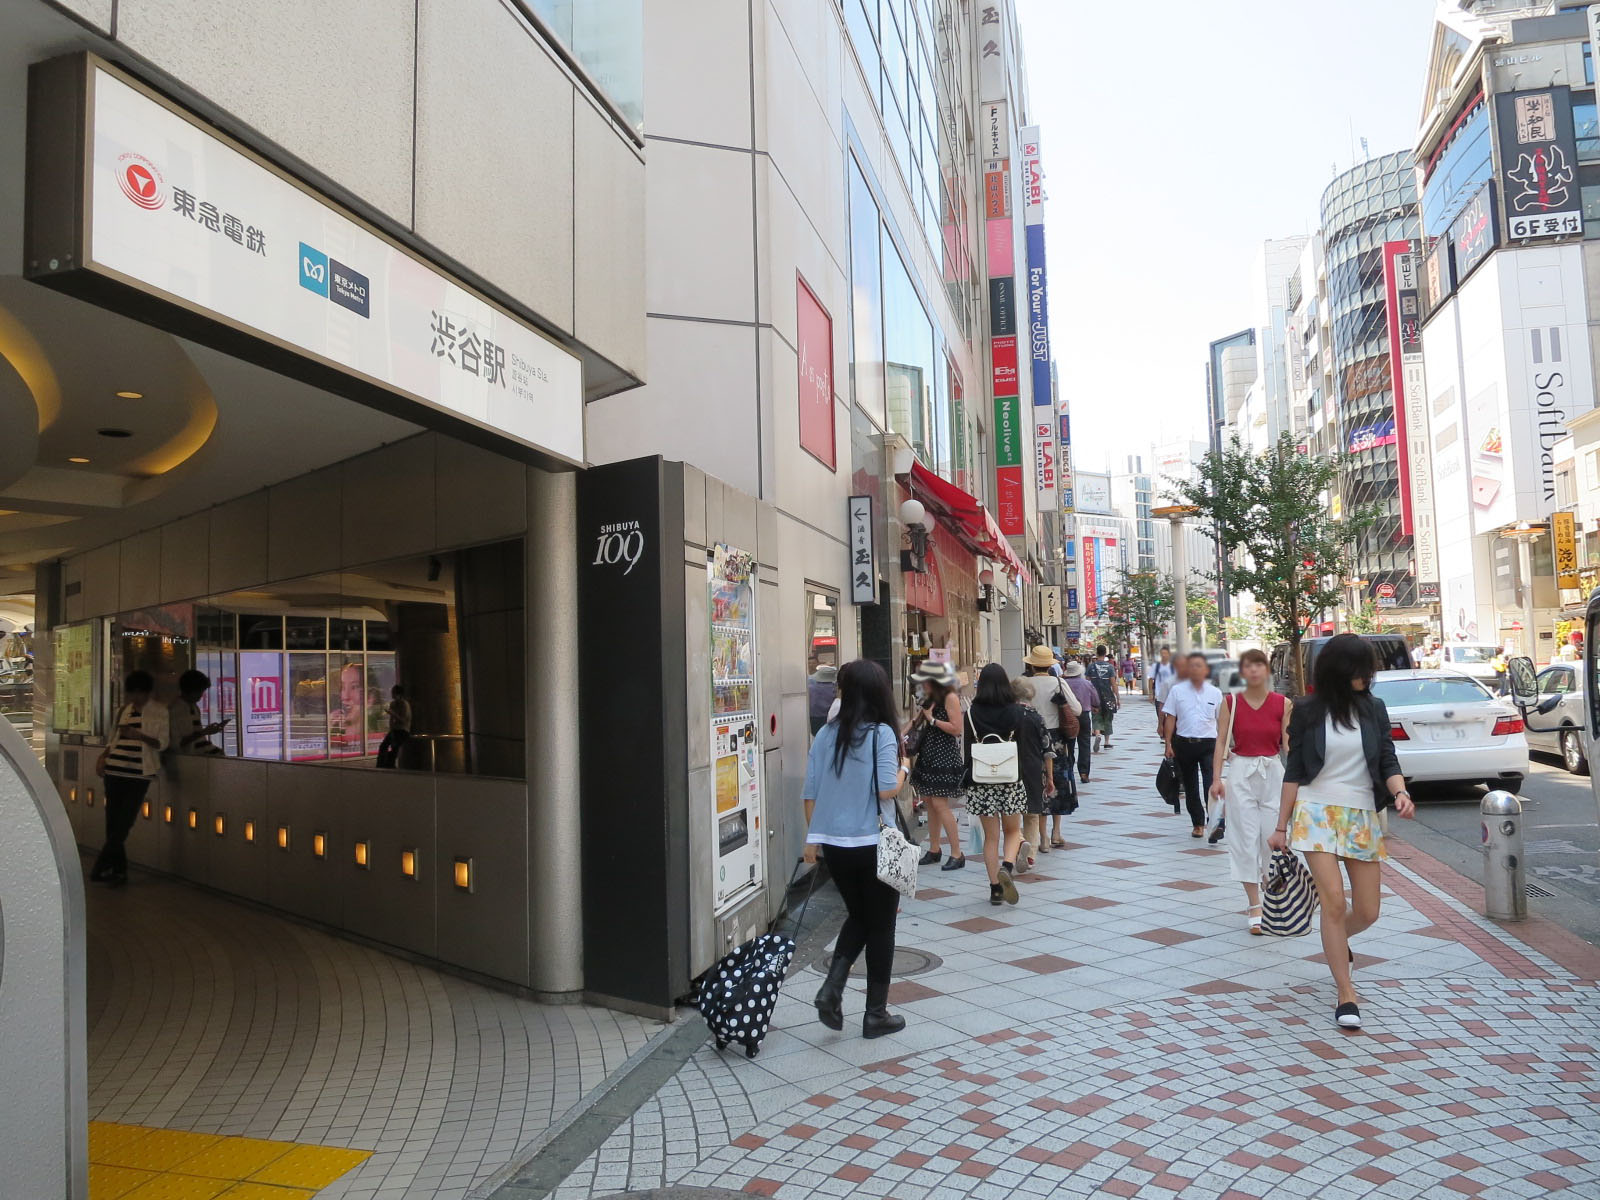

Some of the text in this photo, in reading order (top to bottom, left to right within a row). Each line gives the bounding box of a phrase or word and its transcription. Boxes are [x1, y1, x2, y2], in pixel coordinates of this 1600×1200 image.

[1030, 160, 1041, 205] LABI
[172, 186, 267, 257] 東急電鉄
[334, 273, 366, 297] 東京メトロ
[336, 284, 350, 297] Tokyo
[1031, 267, 1042, 286] For
[431, 310, 506, 389] 渋谷駅
[1032, 322, 1048, 362] JUST
[1002, 401, 1012, 453] Neolive
[1410, 384, 1422, 431] SoftBank
[1042, 441, 1054, 489] LABI
[1415, 458, 1427, 504] SoftBank
[600, 520, 640, 533] SHIBUYA
[592, 530, 644, 576] 109
[855, 548, 871, 588] 玉久
[1420, 530, 1432, 579] SoftBank
